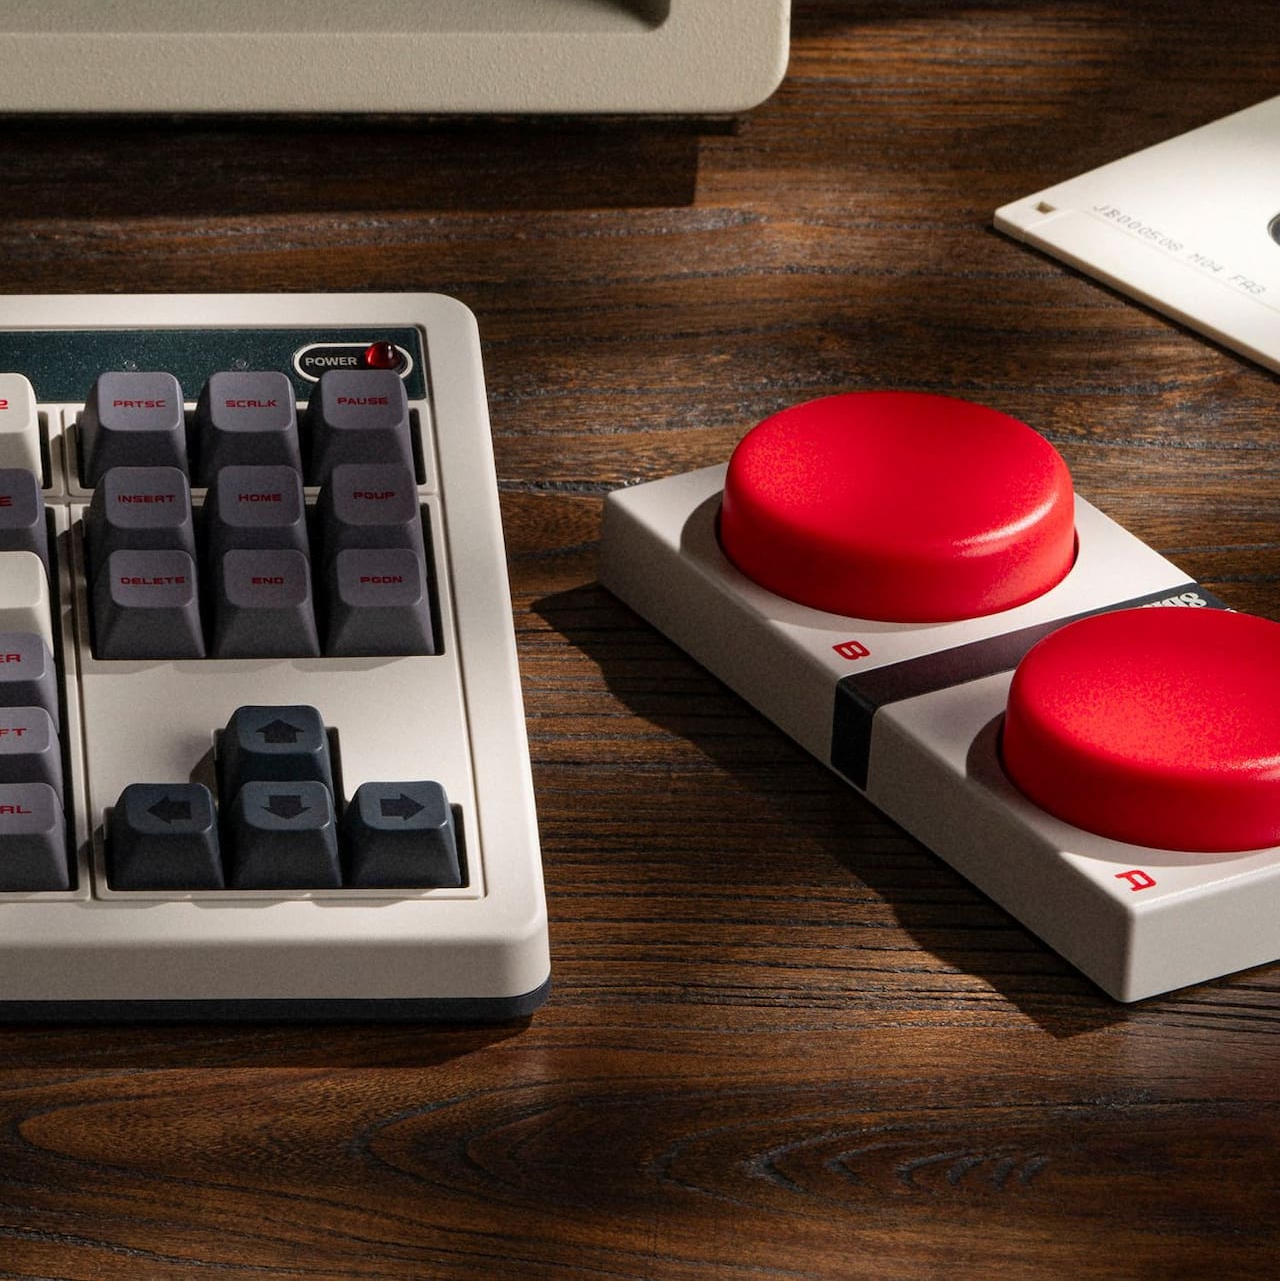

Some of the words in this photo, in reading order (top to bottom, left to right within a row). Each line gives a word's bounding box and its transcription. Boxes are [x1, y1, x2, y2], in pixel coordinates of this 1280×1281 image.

[304, 355, 359, 368] POWER
[112, 398, 167, 408] PRTSC
[226, 400, 276, 408] SCRLK
[336, 397, 388, 406] PAUSE
[118, 494, 175, 502] INSERT
[238, 493, 282, 501] HOME
[352, 491, 396, 500] PGUP
[121, 576, 184, 585] DELETE
[252, 577, 282, 585] END
[360, 576, 401, 584] PGDN
[833, 640, 871, 660] B
